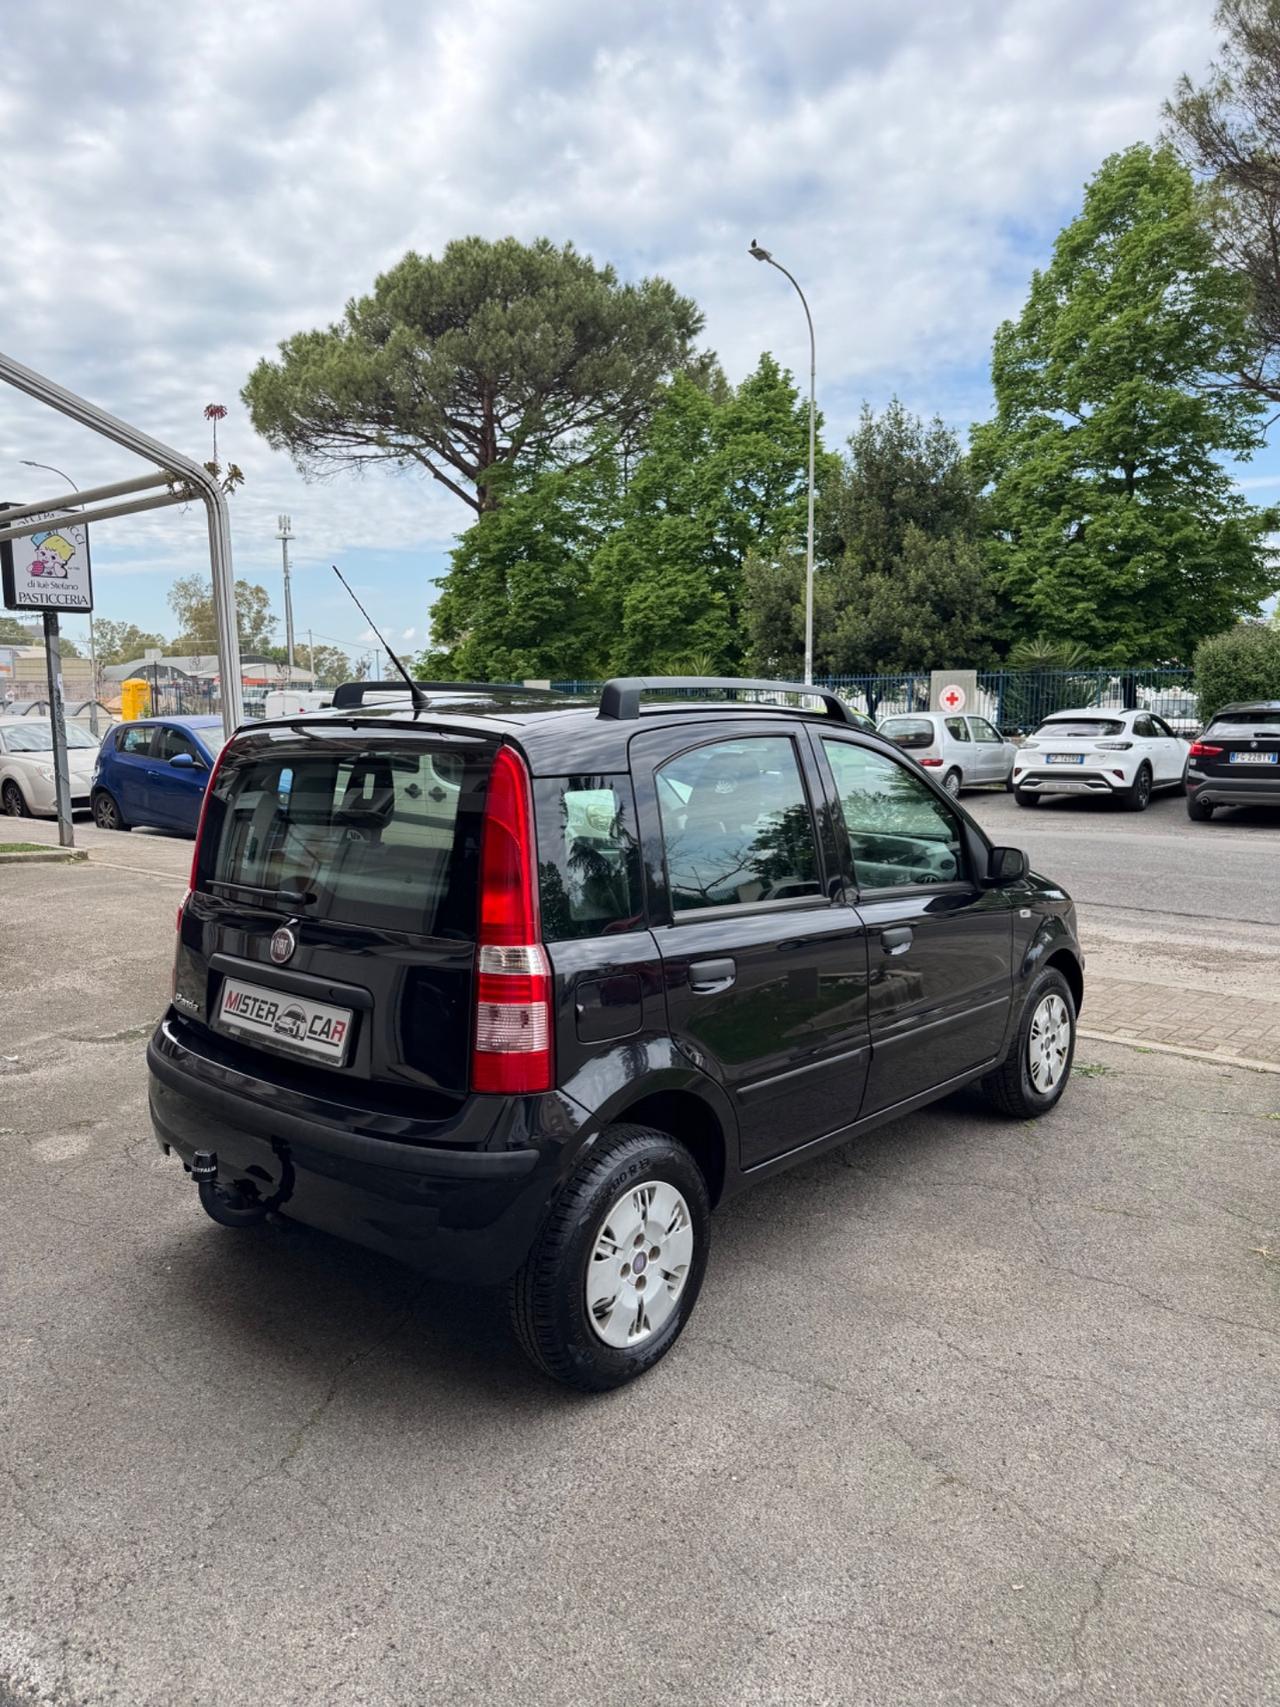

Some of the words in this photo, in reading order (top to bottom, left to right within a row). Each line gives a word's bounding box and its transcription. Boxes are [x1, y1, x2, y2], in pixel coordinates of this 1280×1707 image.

[18, 591, 88, 605] PASTICCERIA
[223, 990, 279, 1023] MISTER
[308, 1014, 347, 1043] CAR
